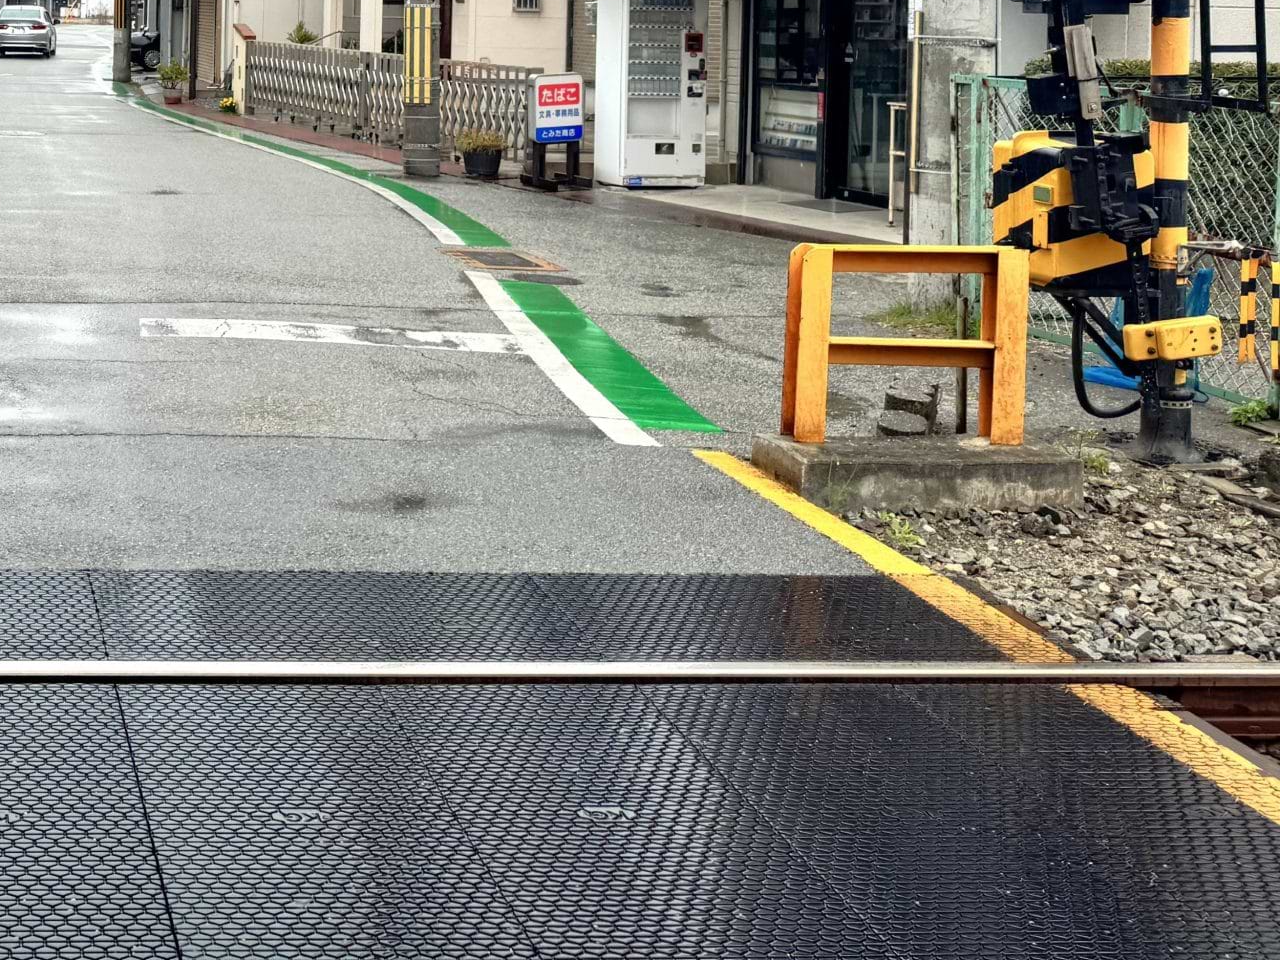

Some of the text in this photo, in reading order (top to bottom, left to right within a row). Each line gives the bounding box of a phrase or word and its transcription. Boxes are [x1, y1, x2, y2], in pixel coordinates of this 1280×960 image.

[541, 87, 577, 103] たばこ
[542, 128, 576, 138] とみた商店
